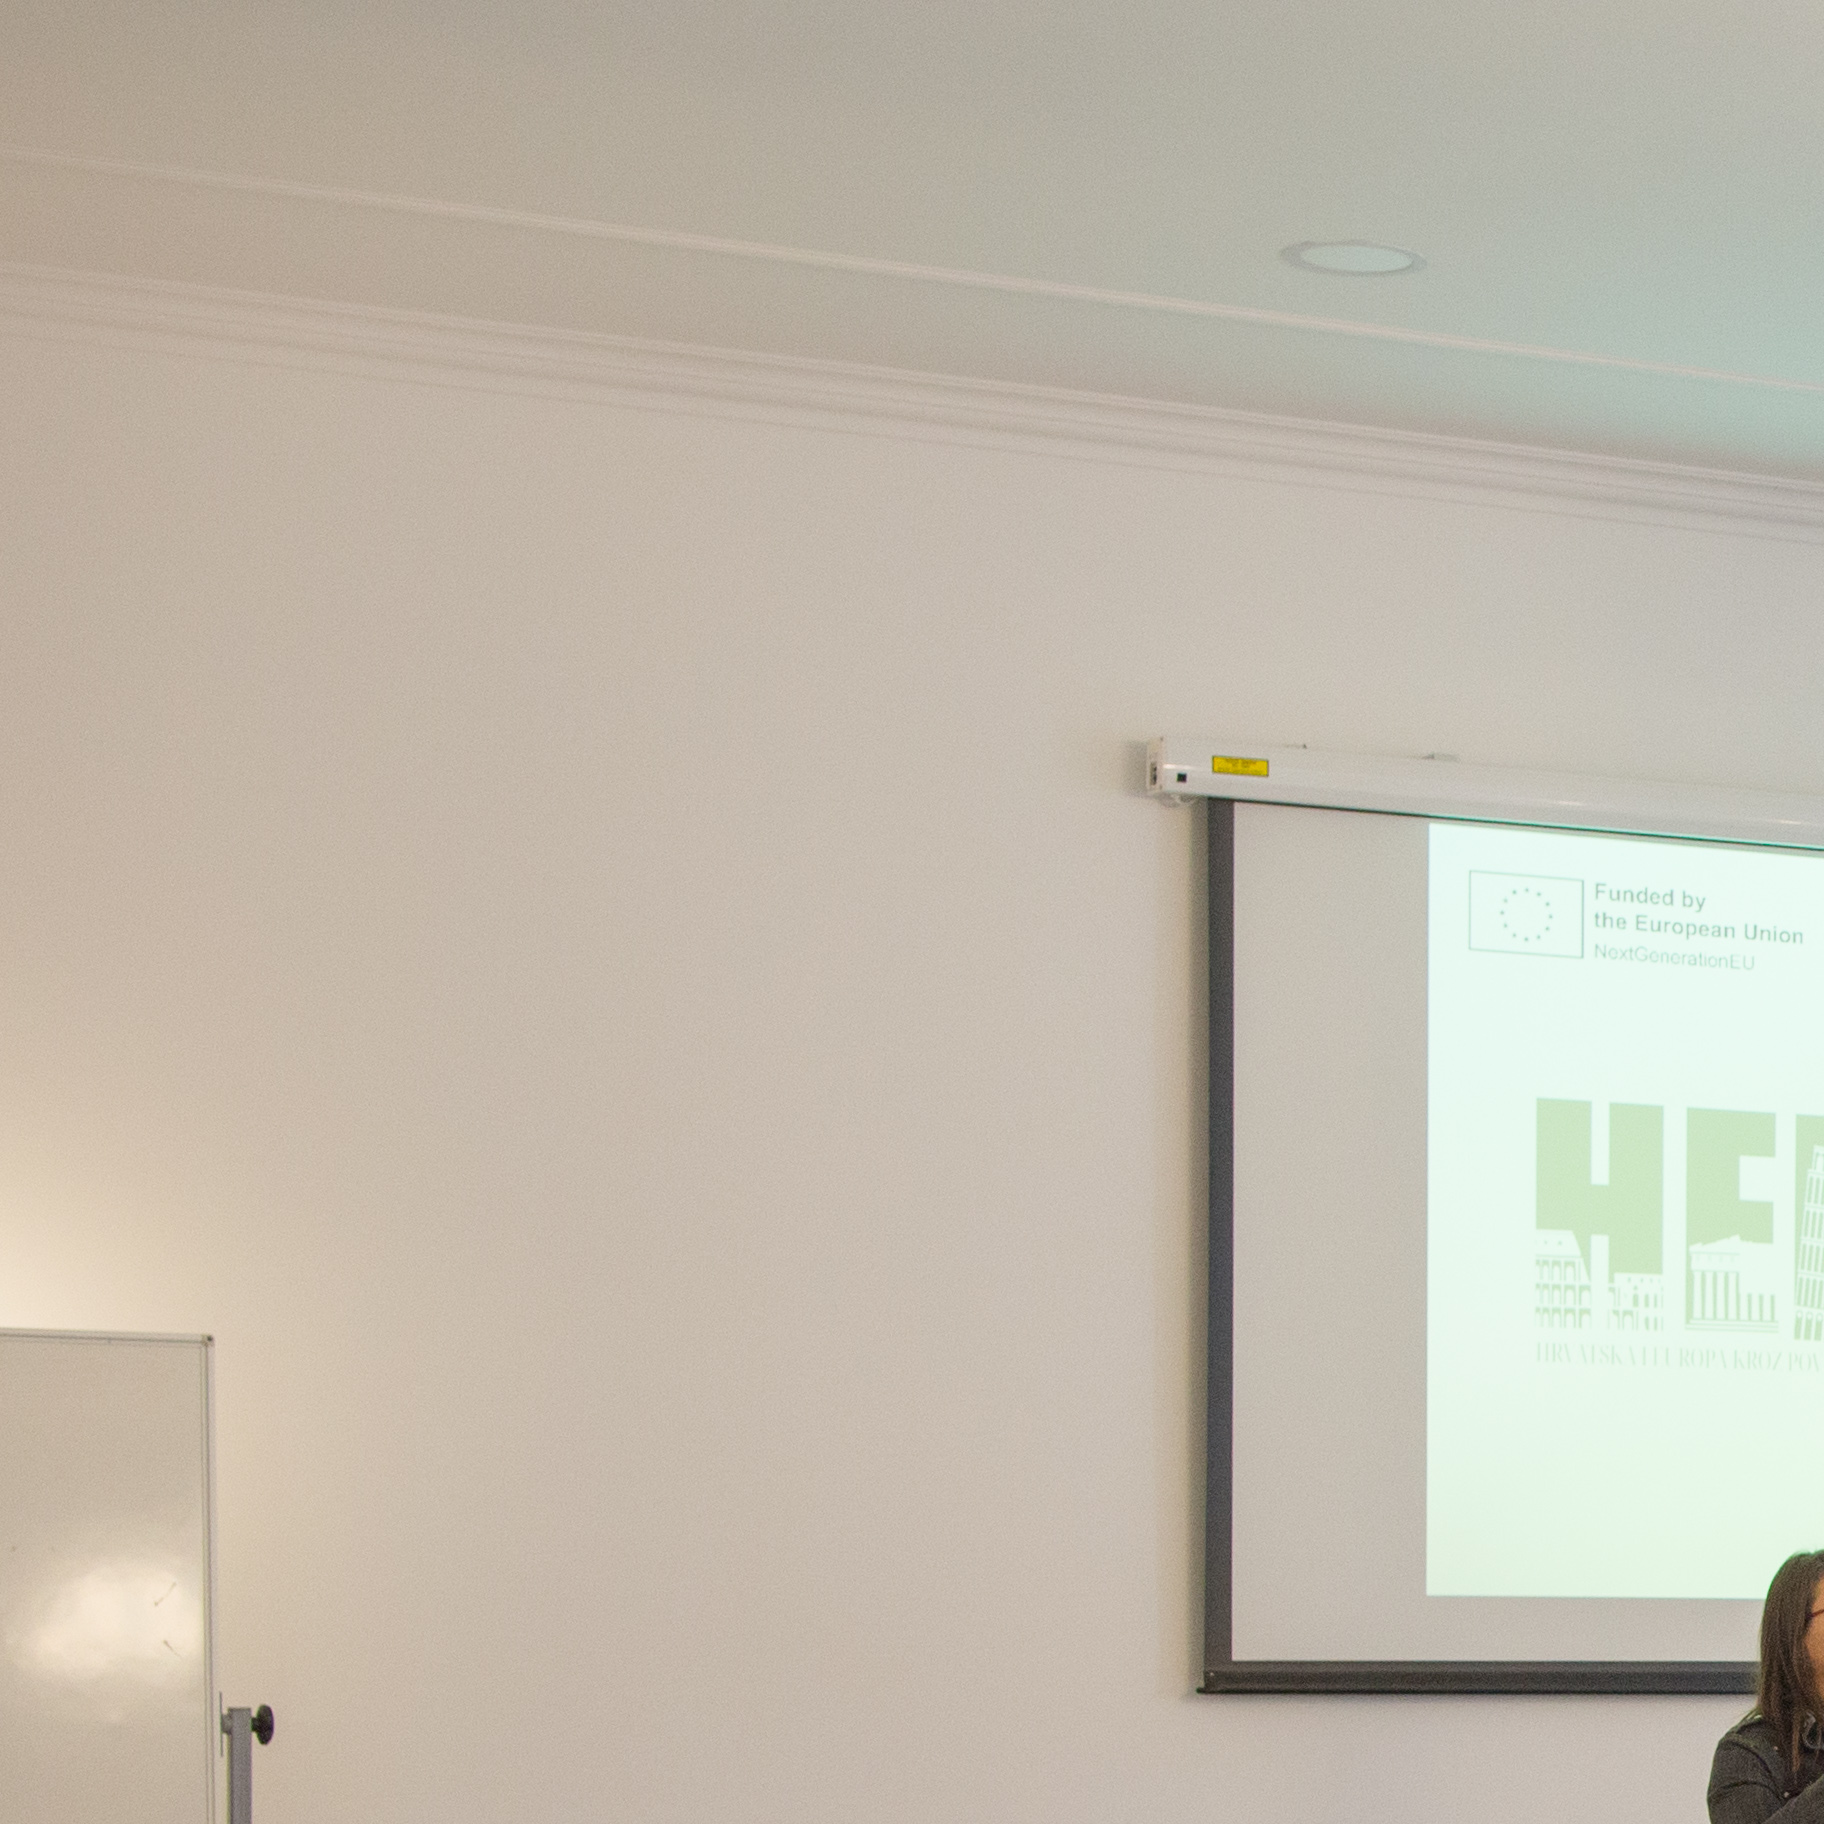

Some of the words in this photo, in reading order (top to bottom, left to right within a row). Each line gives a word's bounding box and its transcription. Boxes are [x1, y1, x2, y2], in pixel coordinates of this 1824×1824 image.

[1595, 883, 1674, 906] Funded
[1682, 889, 1706, 912] by
[1594, 912, 1627, 930] the
[1635, 914, 1736, 940] European
[1744, 923, 1804, 945] Union
[1594, 943, 1756, 970] NextGenerationEU
